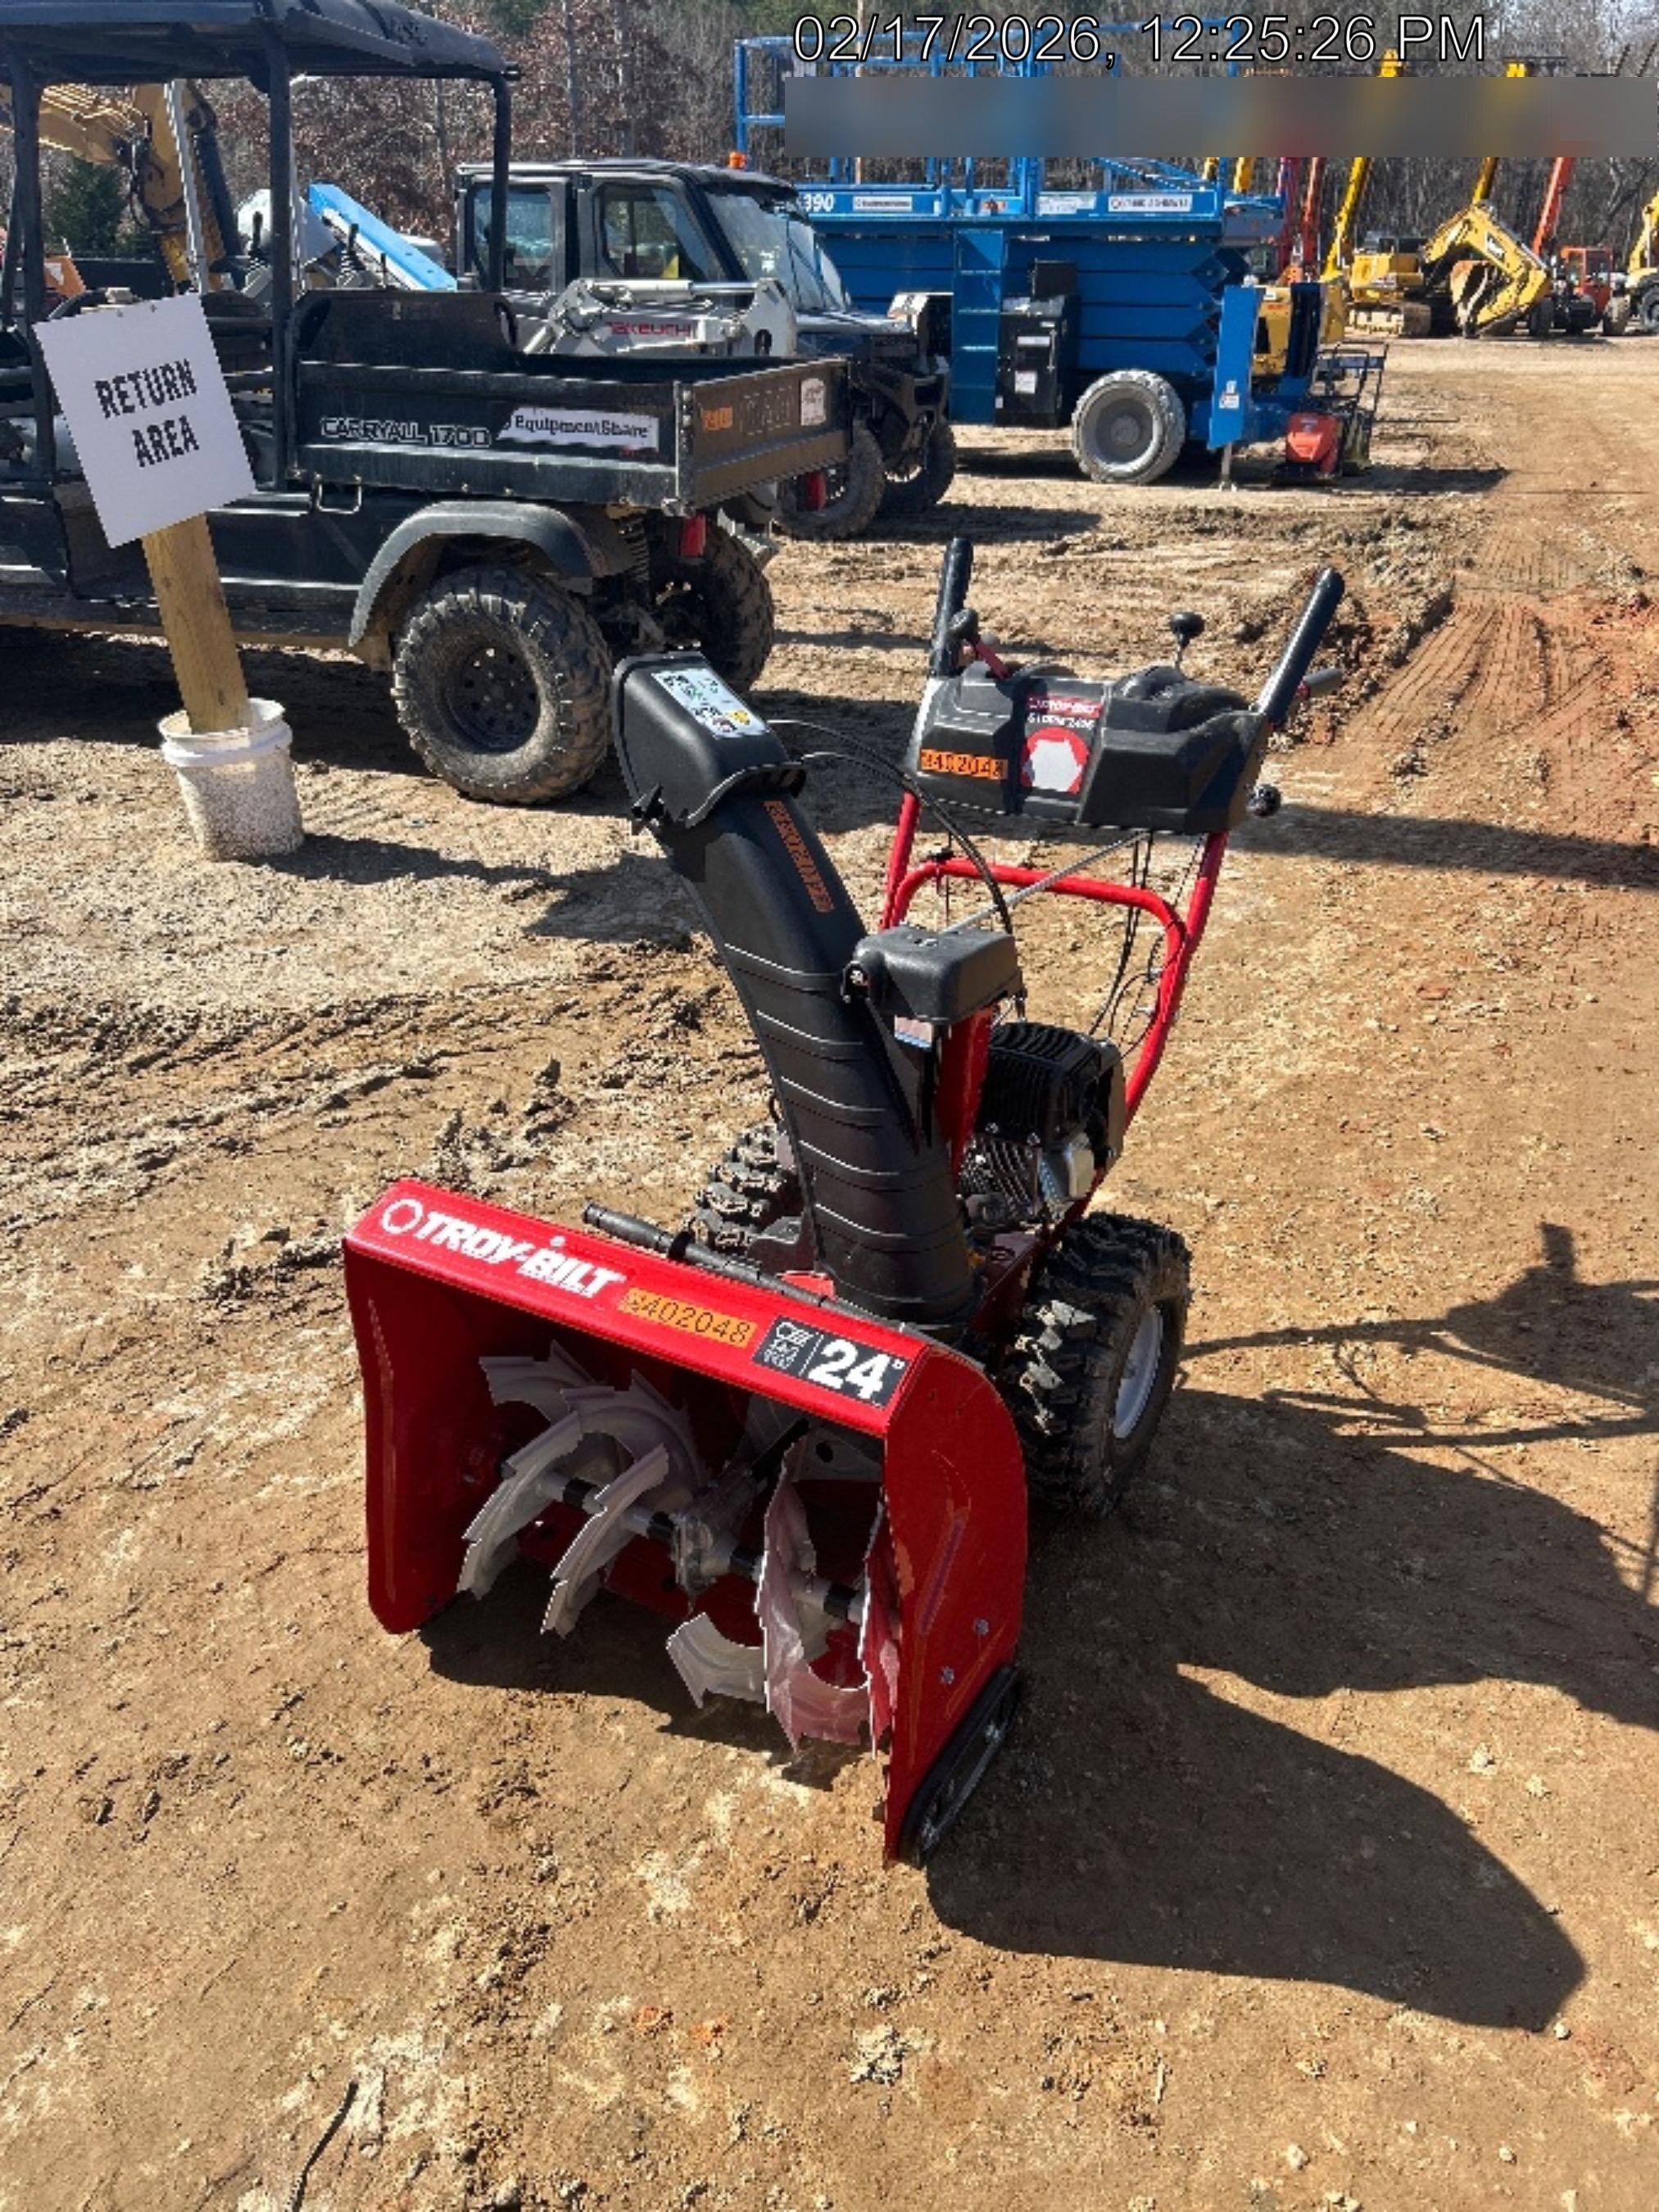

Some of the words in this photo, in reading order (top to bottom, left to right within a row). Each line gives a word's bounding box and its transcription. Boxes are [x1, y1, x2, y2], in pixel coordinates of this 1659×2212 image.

[796, 193, 835, 213] 390
[94, 358, 197, 419] RETURN
[132, 415, 200, 468] AREA
[320, 416, 428, 446] CARRYALL
[428, 424, 492, 448] 1700
[414, 1210, 628, 1299] TROY-BILT
